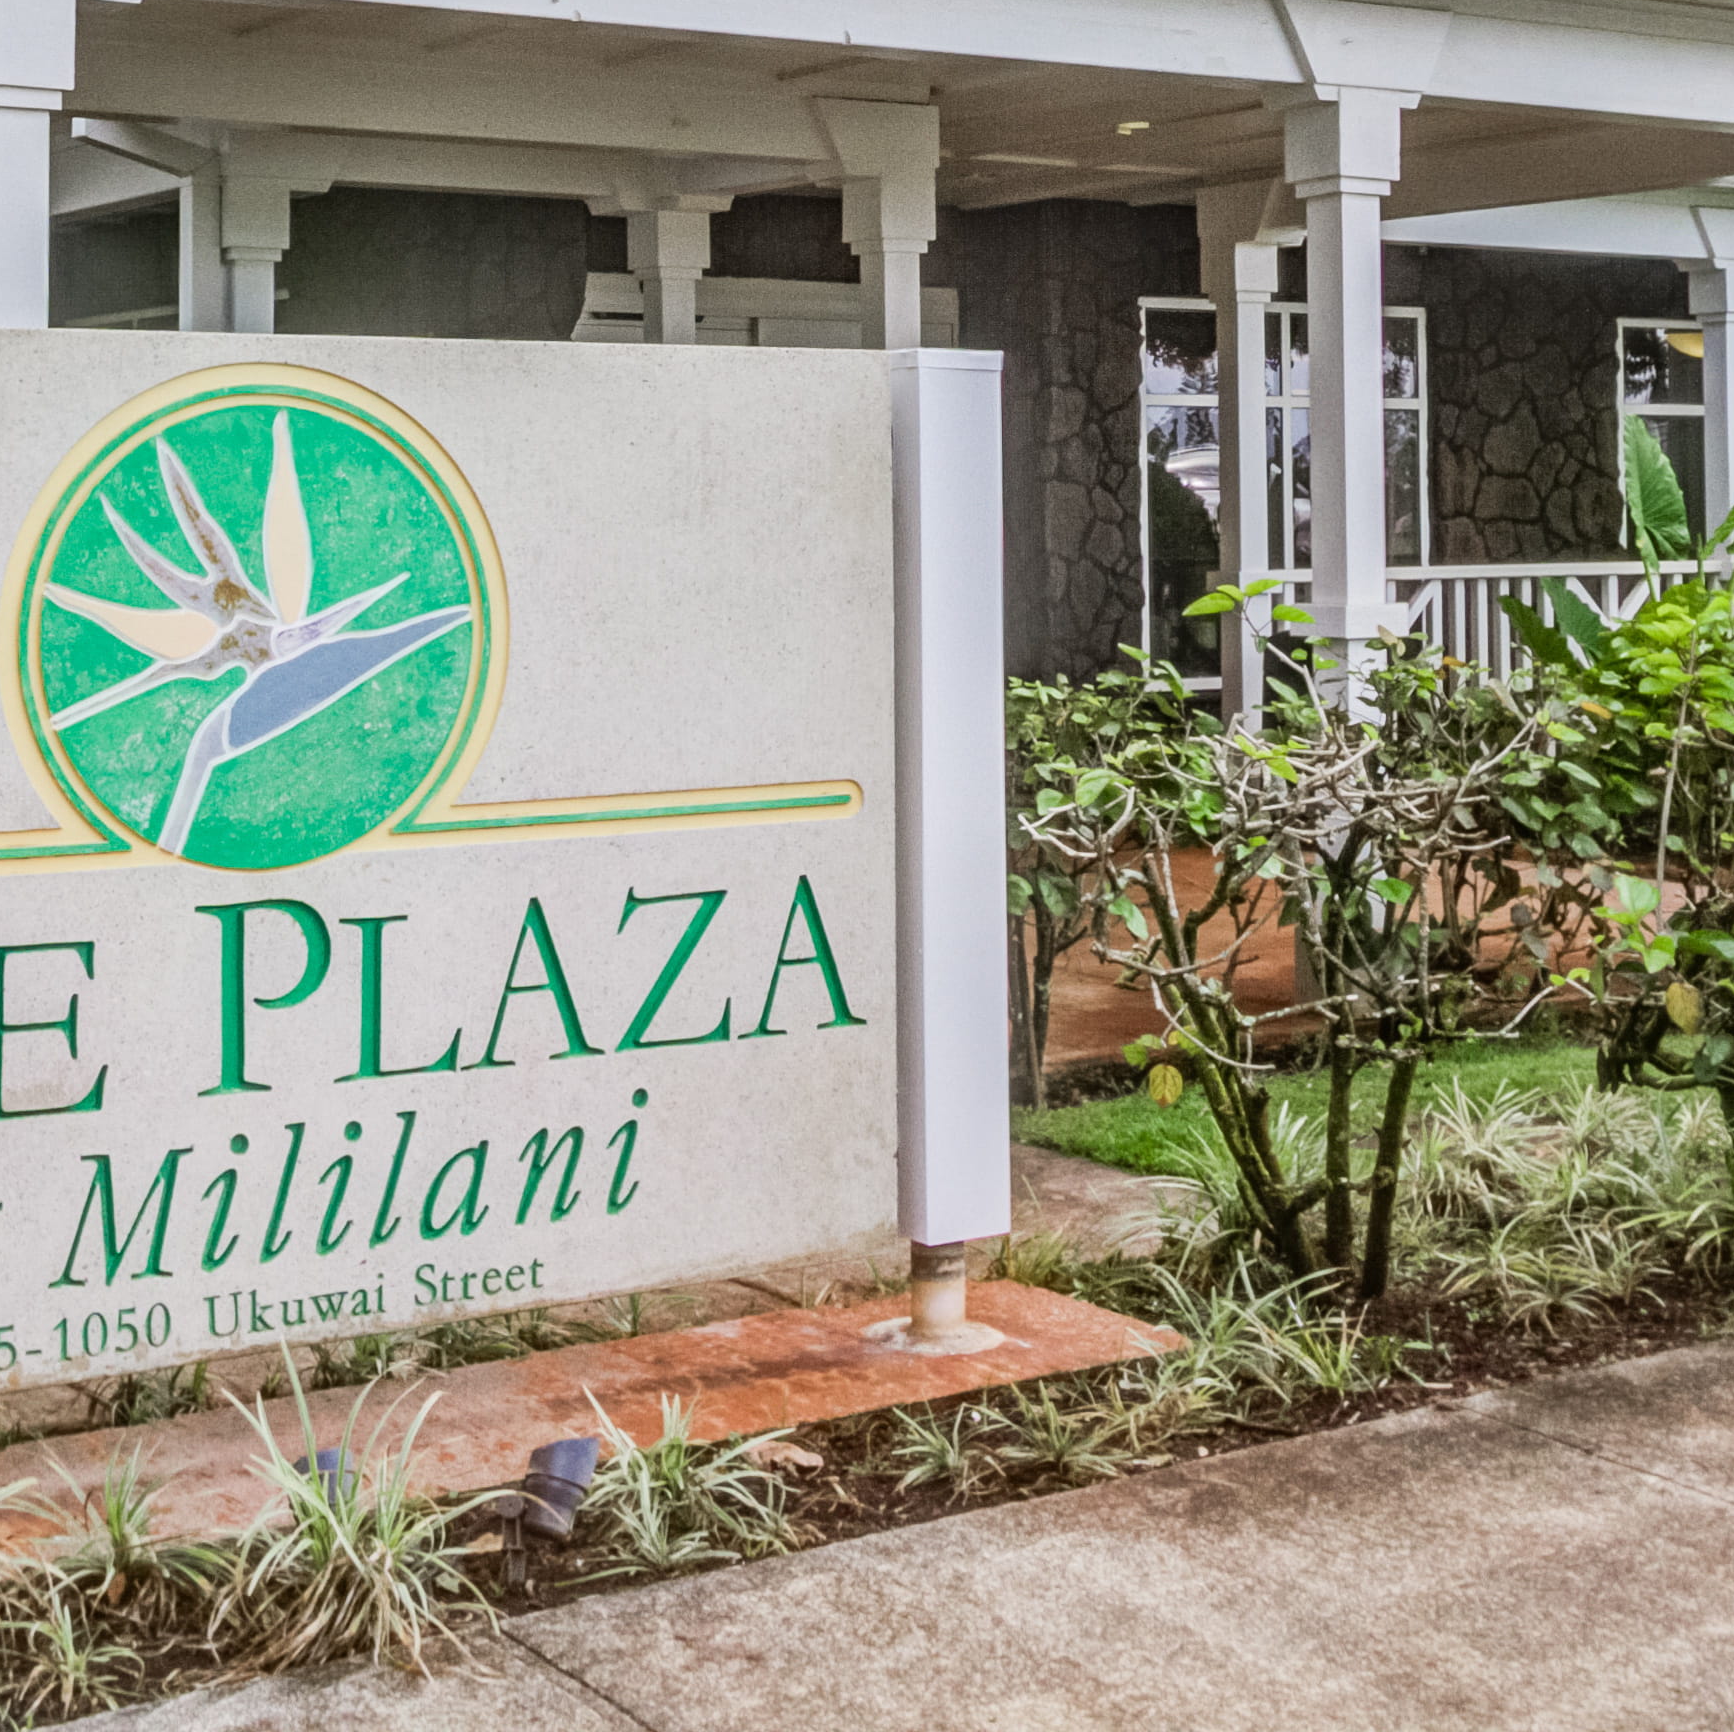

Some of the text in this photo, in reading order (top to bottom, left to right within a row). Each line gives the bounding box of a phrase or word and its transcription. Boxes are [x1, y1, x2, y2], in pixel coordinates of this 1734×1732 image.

[196, 873, 867, 1098] PLAZA
[48, 1088, 650, 1289] Mililani
[202, 1272, 387, 1337] Ukuwai
[414, 1258, 545, 1306] Street
